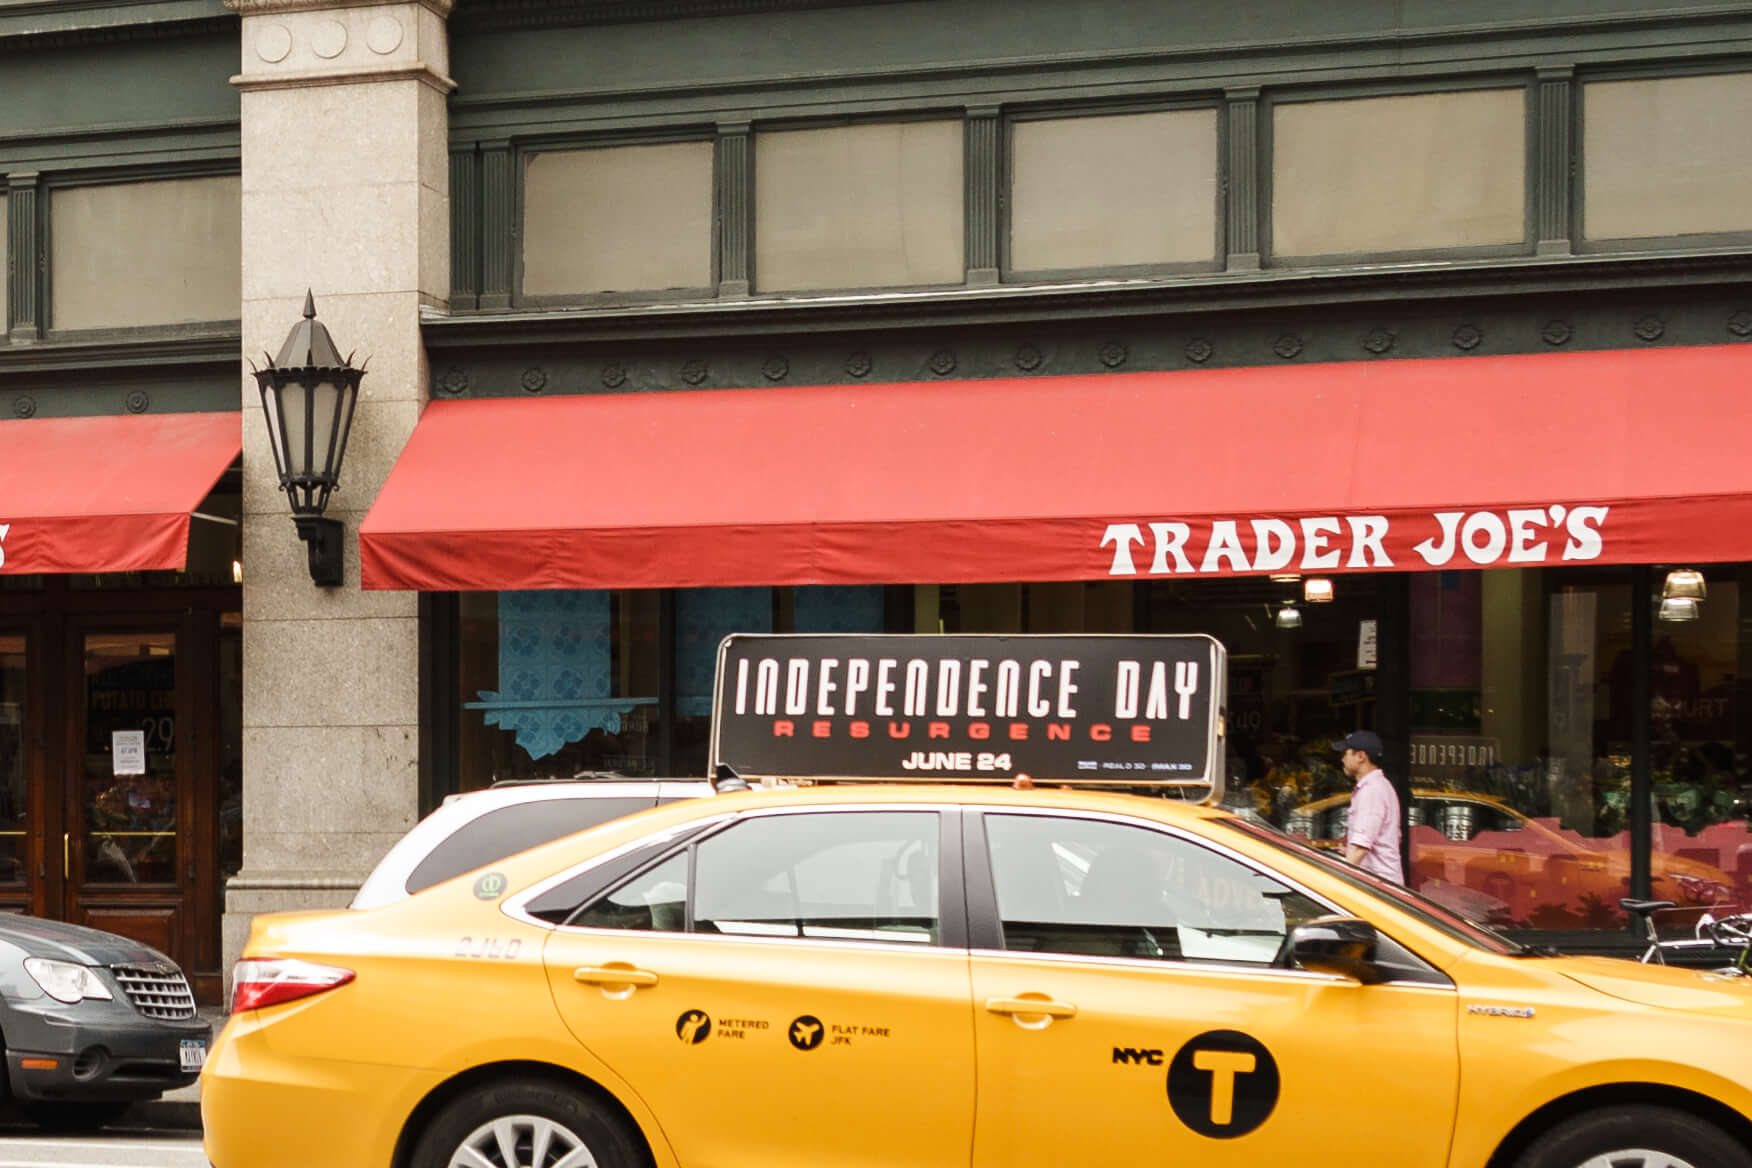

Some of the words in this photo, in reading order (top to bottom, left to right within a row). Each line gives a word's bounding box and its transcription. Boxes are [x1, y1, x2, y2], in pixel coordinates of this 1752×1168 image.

[1099, 515, 1394, 576] TRADER
[1413, 504, 1609, 567] JOE'S
[734, 658, 1081, 719] INDEPENDENCE
[1114, 660, 1199, 720] DAY
[773, 720, 1152, 743] RESURGENCE
[902, 751, 972, 771] JUNE
[976, 752, 1013, 771] 24
[719, 1018, 770, 1030] METERED
[832, 1025, 858, 1035] FLAT
[862, 1027, 891, 1037] FARE
[718, 1029, 745, 1039] FARE
[831, 1036, 852, 1046] JFK
[1112, 1047, 1164, 1066] NYC
[1193, 1049, 1257, 1125] T
